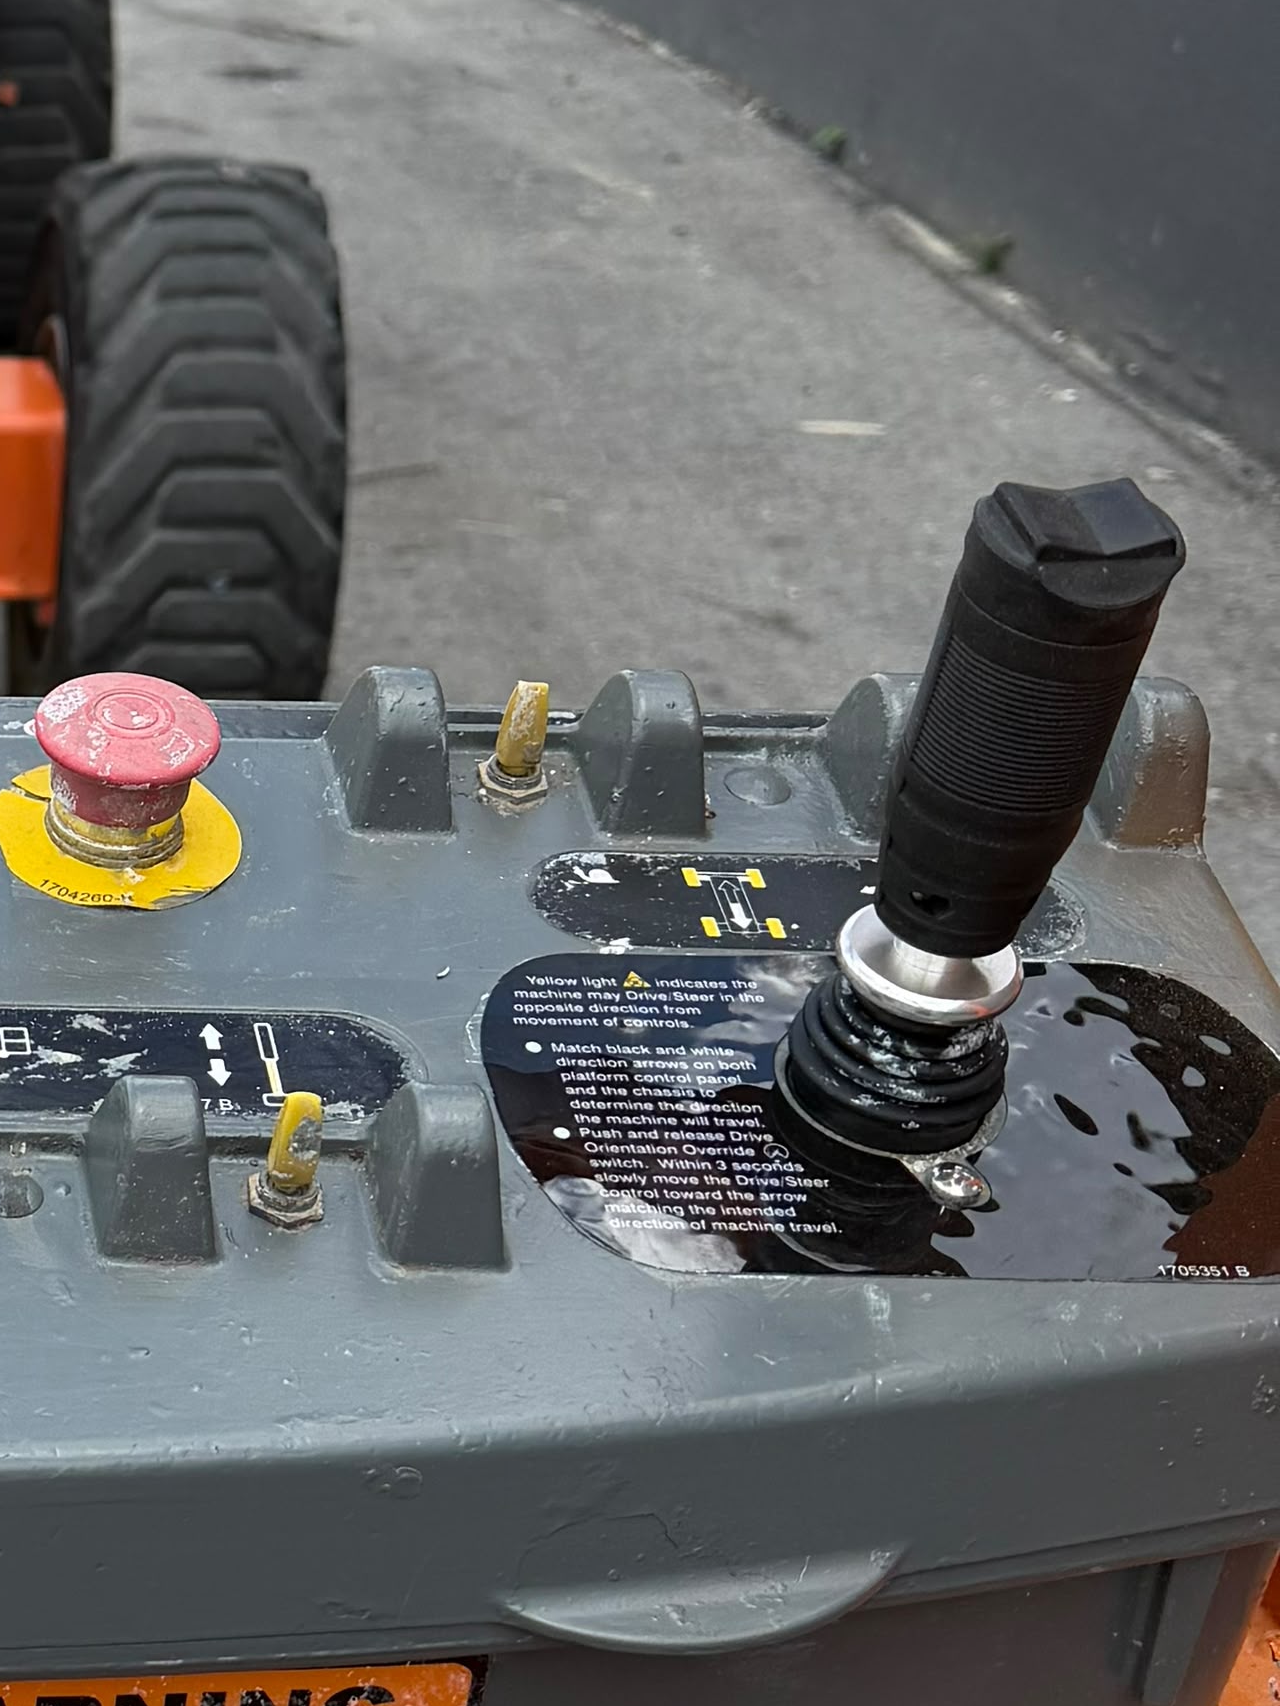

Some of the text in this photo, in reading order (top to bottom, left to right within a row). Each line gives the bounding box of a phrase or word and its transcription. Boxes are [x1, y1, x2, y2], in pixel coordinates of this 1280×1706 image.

[574, 1114, 765, 1127] the machine will travel.
[1157, 1265, 1249, 1276] 1705351 B
